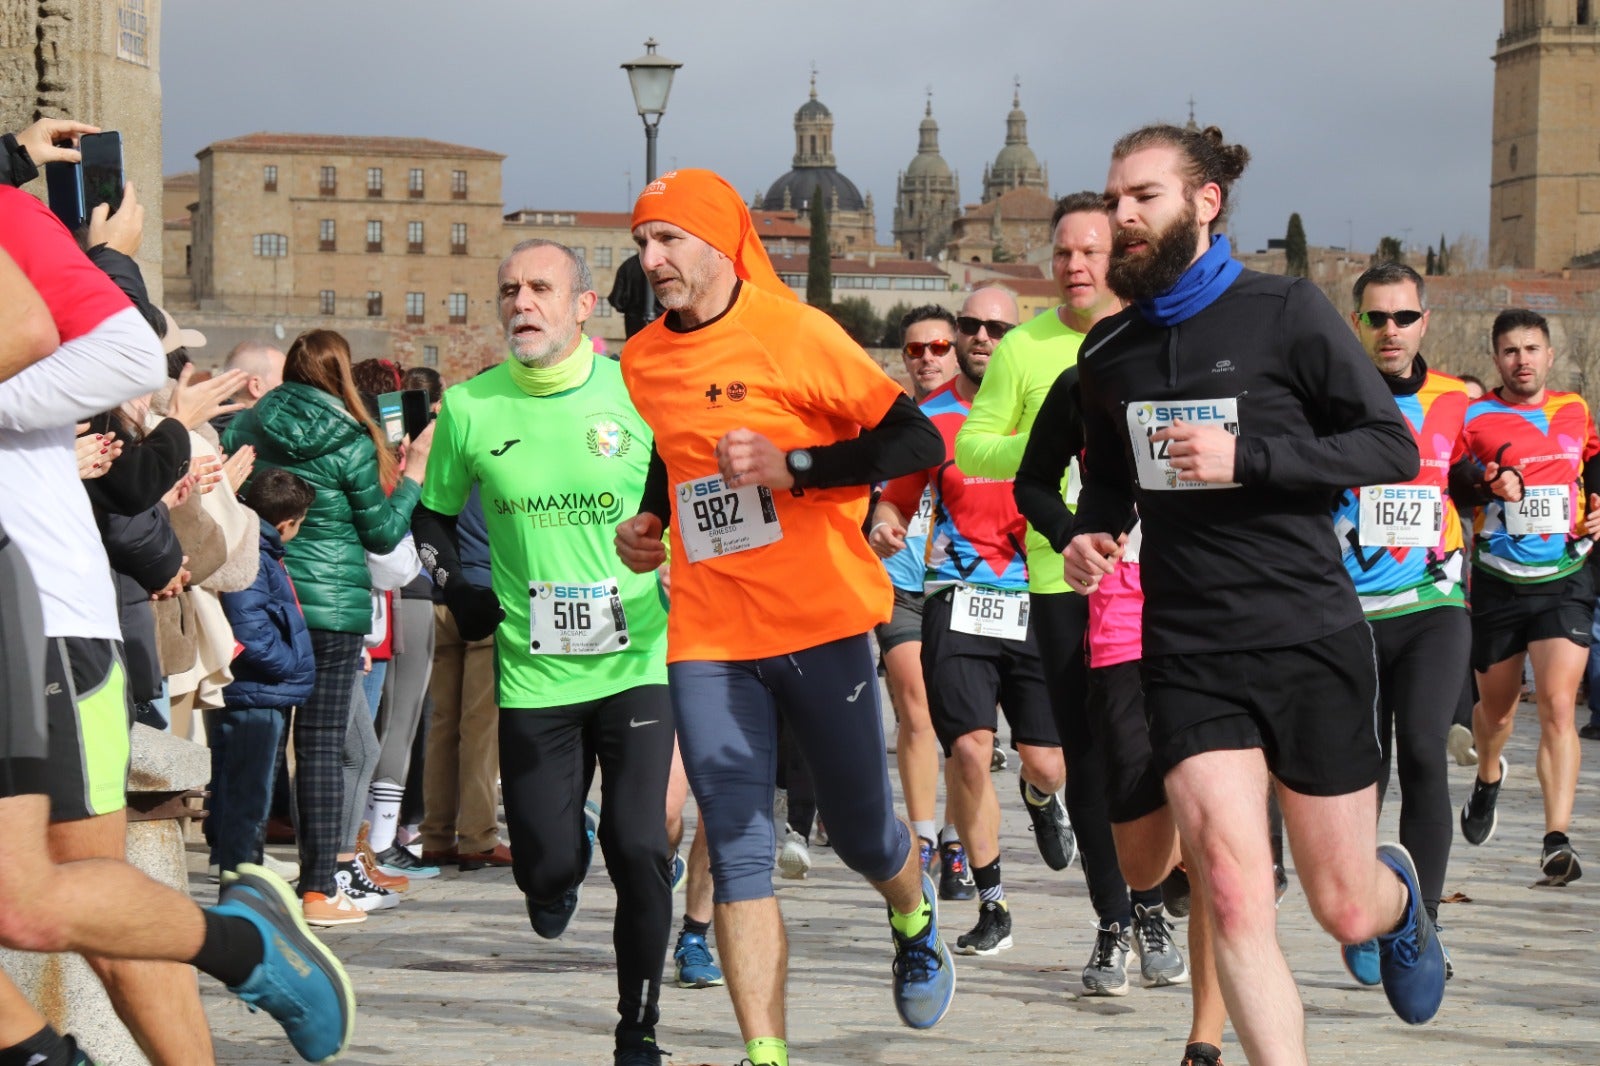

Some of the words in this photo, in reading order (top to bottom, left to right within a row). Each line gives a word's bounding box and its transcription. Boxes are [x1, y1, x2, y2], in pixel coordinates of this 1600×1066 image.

[1155, 405, 1226, 421] SETEL
[1384, 488, 1436, 500] SETEL
[1524, 488, 1564, 497] SETEL
[494, 491, 615, 515] SANMAXIMO
[693, 492, 744, 532] 982
[1519, 499, 1551, 518] 486
[528, 510, 607, 529] TELECOM
[1376, 501, 1422, 526] 1642
[554, 585, 610, 599] SETEL
[553, 601, 591, 630] 516
[968, 596, 1005, 620] 685
